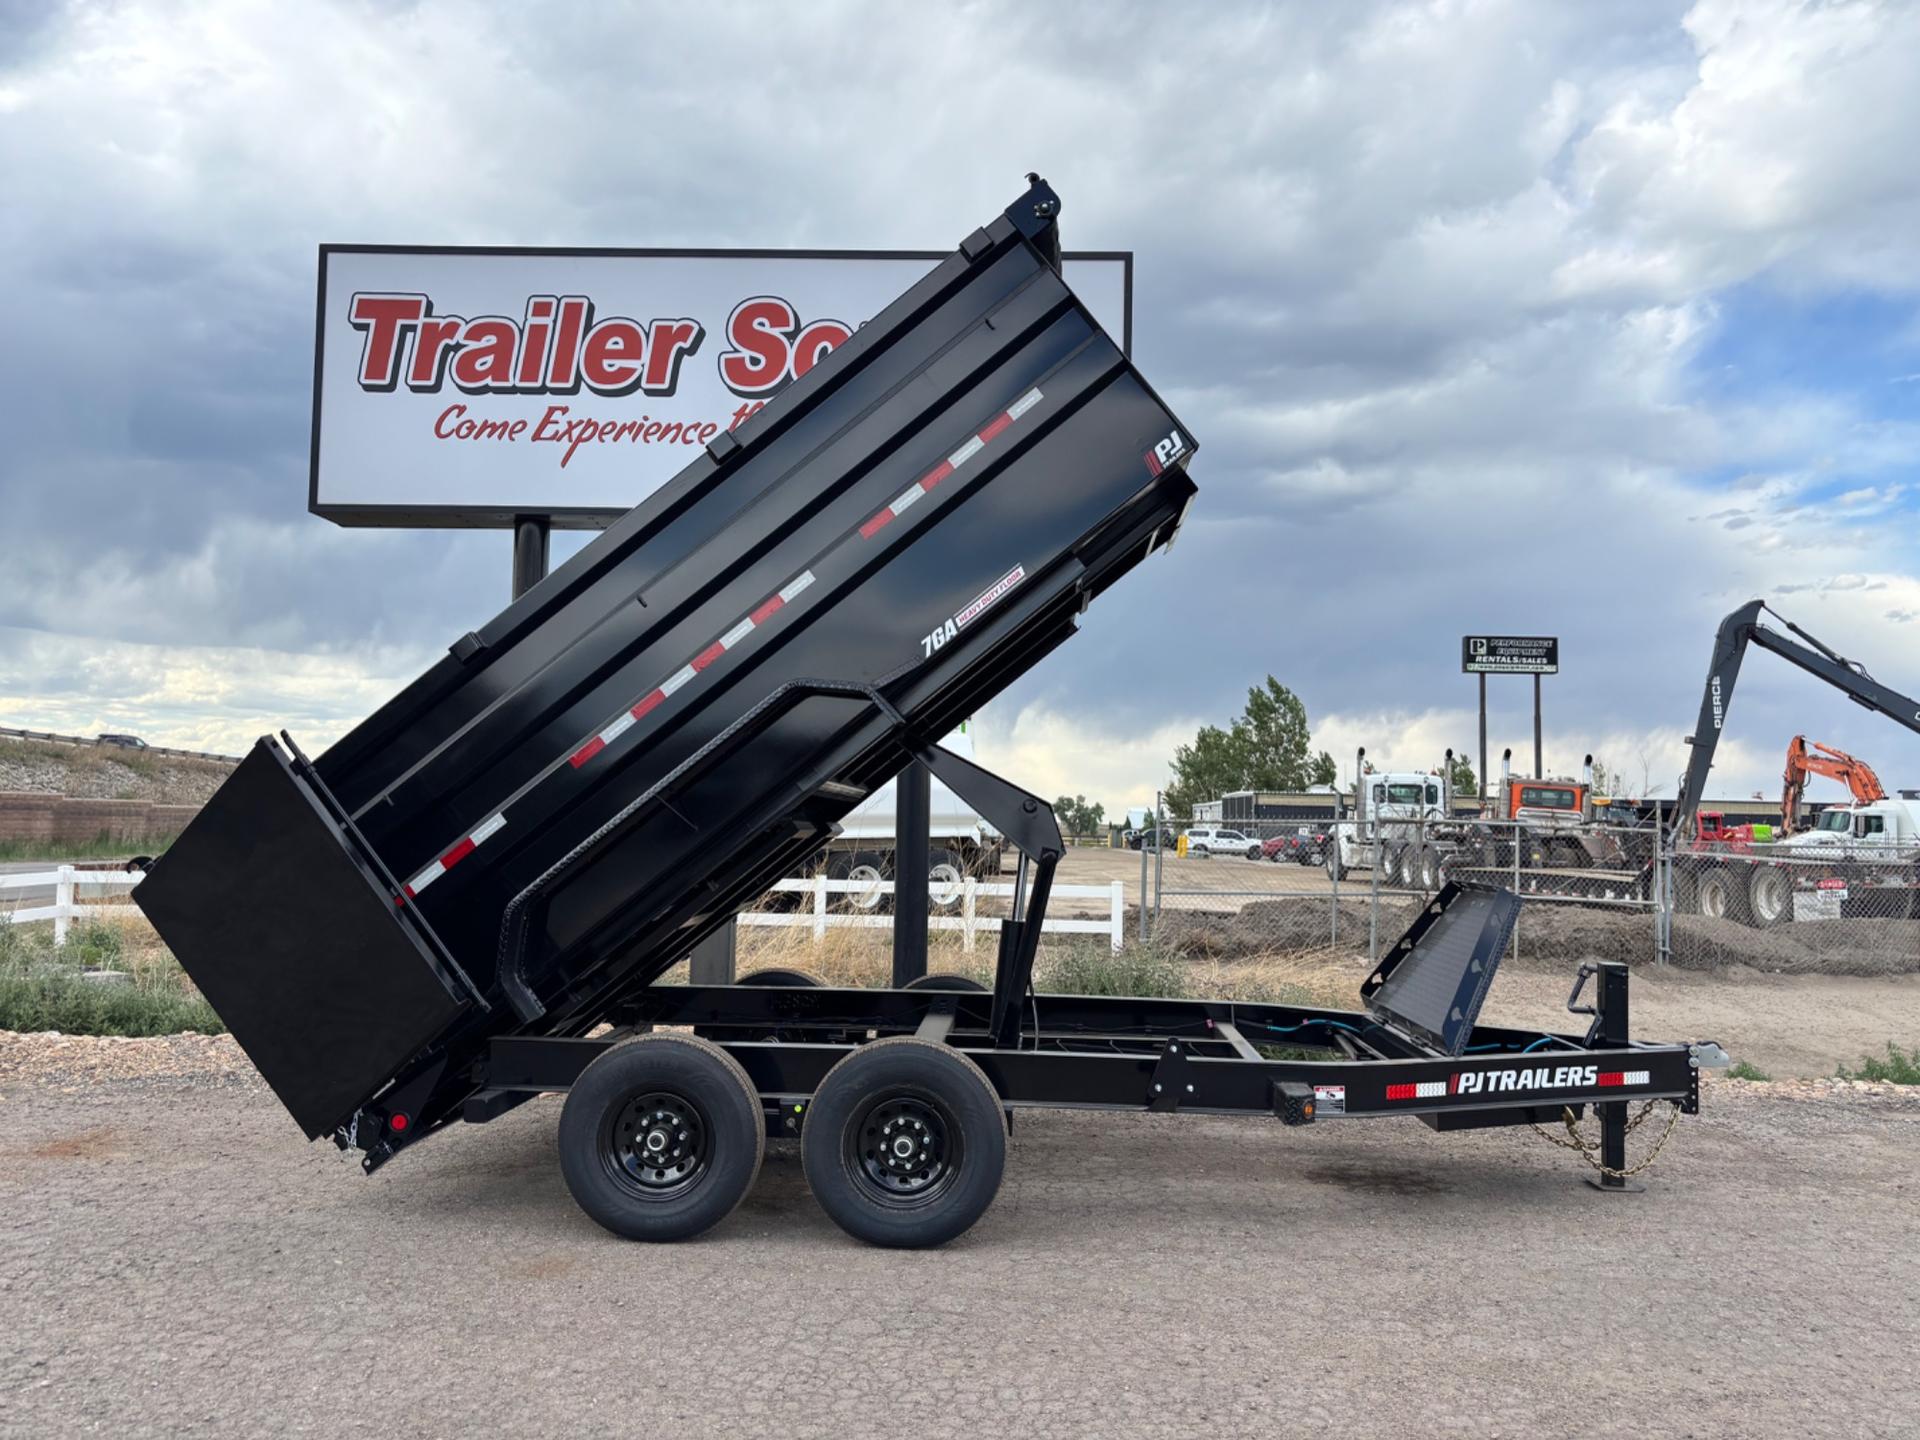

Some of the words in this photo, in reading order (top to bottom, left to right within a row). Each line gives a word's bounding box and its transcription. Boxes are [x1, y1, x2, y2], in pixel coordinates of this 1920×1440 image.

[348, 291, 706, 397] Trailer
[434, 403, 528, 442] Come
[530, 405, 718, 469] Experience
[1154, 430, 1183, 464] PJ
[920, 618, 958, 658] 7GA
[959, 602, 981, 623] HEAVY
[980, 589, 999, 606] DUTY
[999, 570, 1022, 592] FLOOR
[1457, 1072, 1484, 1094] PJ
[1486, 1065, 1598, 1092] TRAILERS
